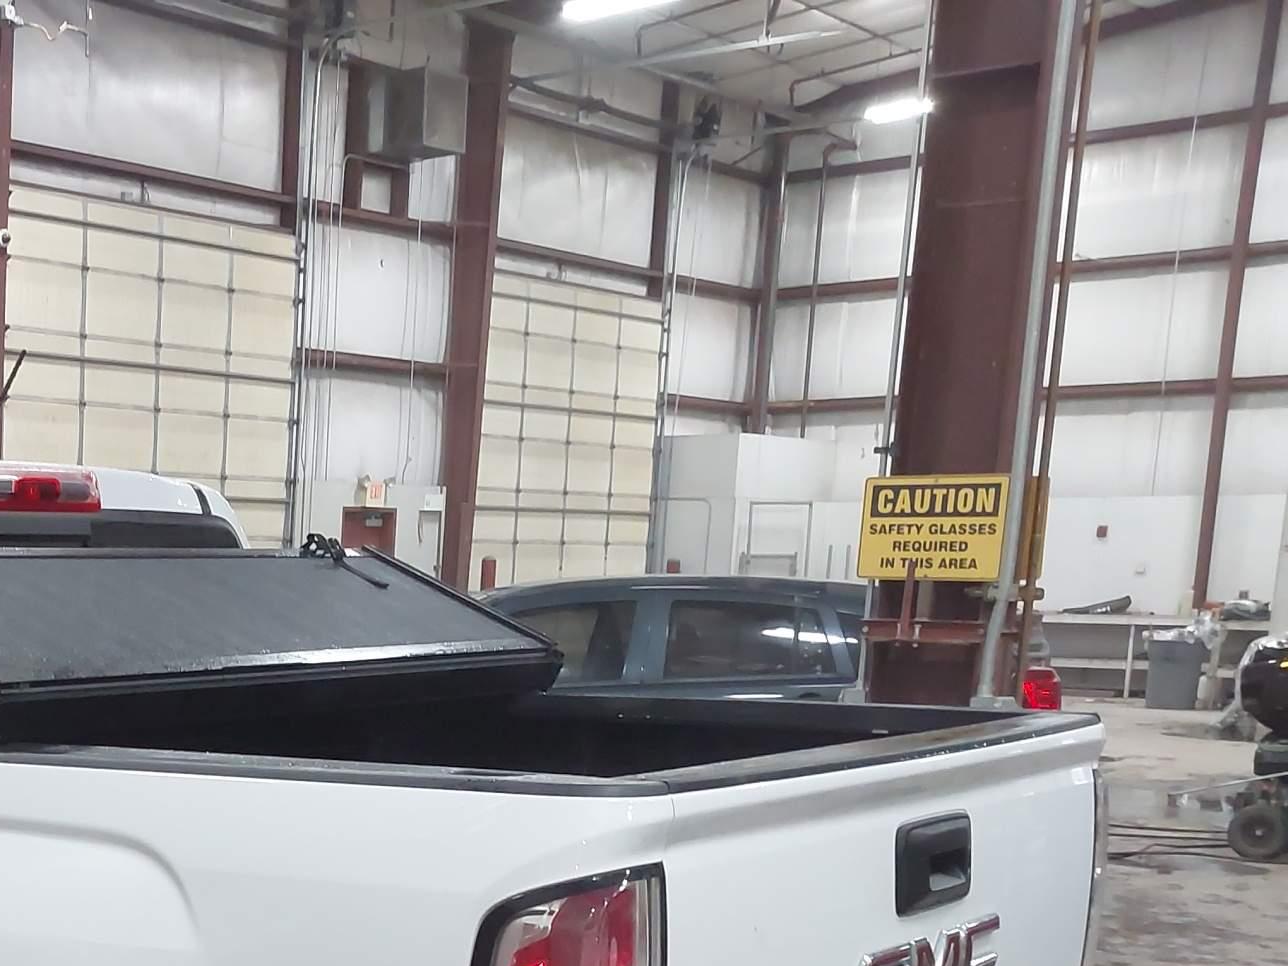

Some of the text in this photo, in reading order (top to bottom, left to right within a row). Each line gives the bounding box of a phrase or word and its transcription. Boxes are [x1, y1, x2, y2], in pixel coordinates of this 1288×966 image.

[877, 488, 995, 514] CAUTION
[869, 523, 997, 535] SAFETY GLASSES
[892, 541, 969, 552] REQUIRED
[880, 558, 895, 568] IN
[938, 558, 978, 569] AREA
